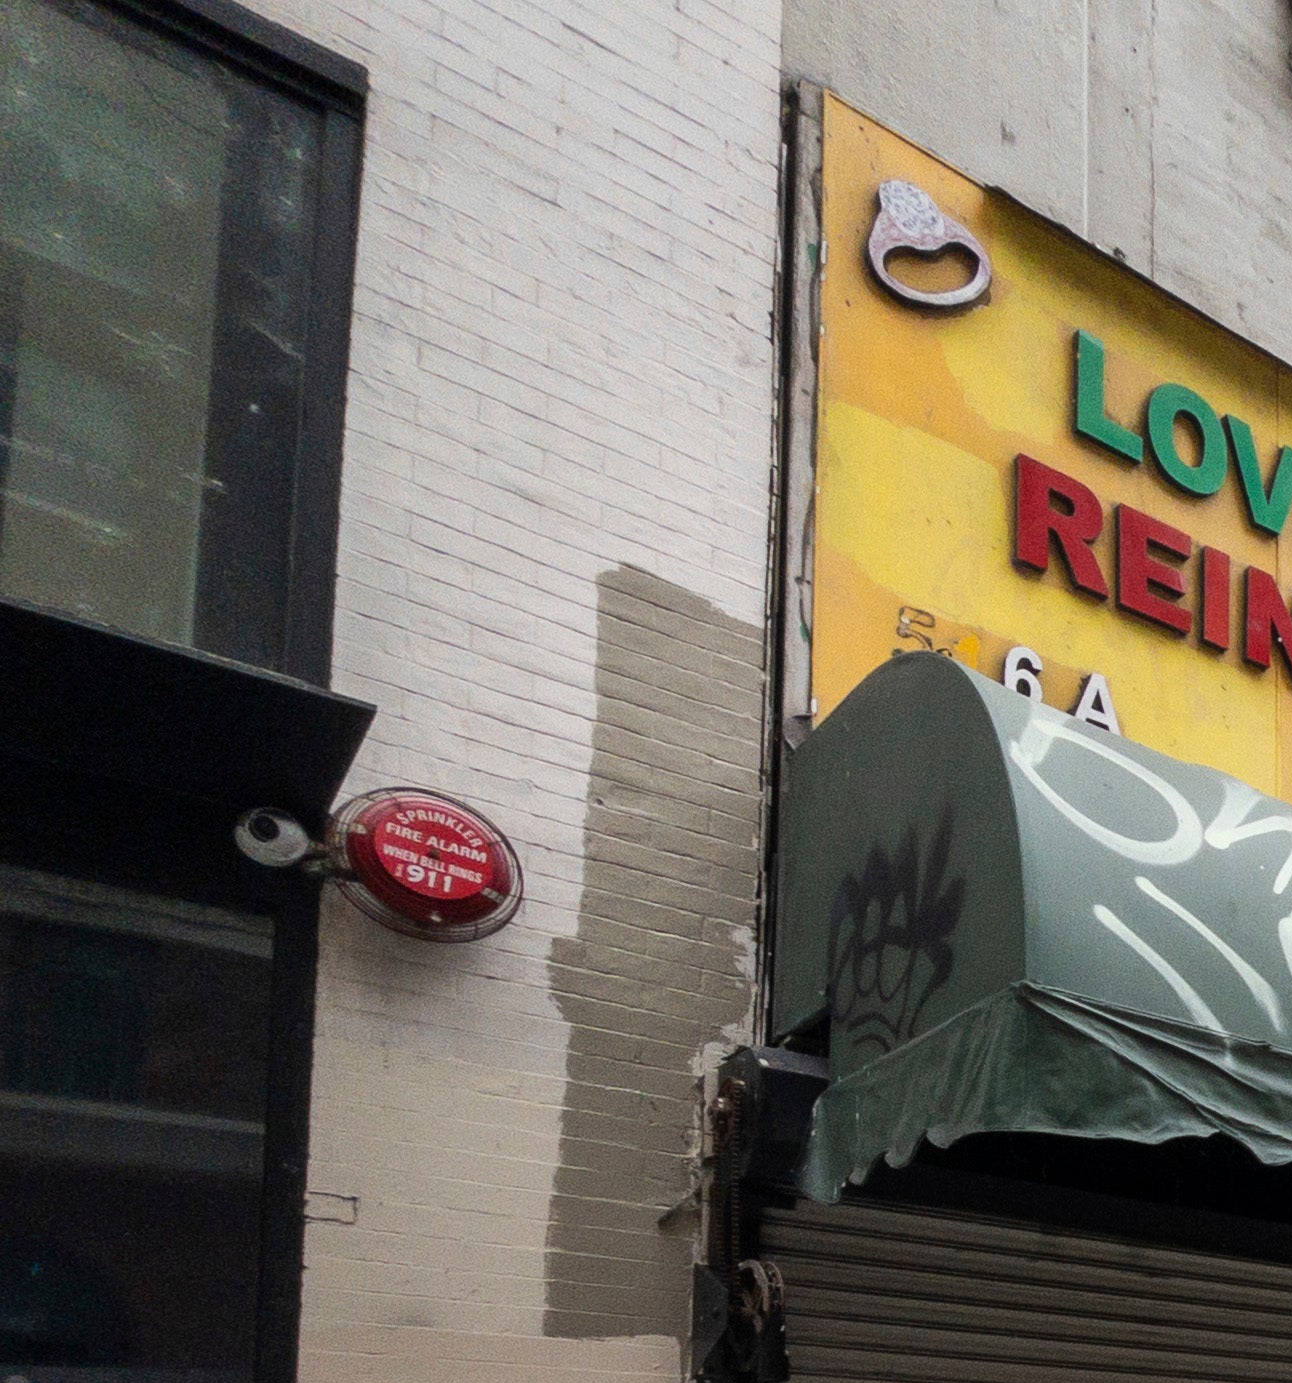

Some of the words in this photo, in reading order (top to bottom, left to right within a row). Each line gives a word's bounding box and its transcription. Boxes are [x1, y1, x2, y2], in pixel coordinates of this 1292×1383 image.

[385, 821, 424, 843] FIRE
[425, 835, 488, 863] ALARM
[395, 809, 483, 848] SPRINKLER
[383, 844, 419, 864] WHEN
[420, 855, 446, 873] BELL
[406, 864, 453, 893] 911
